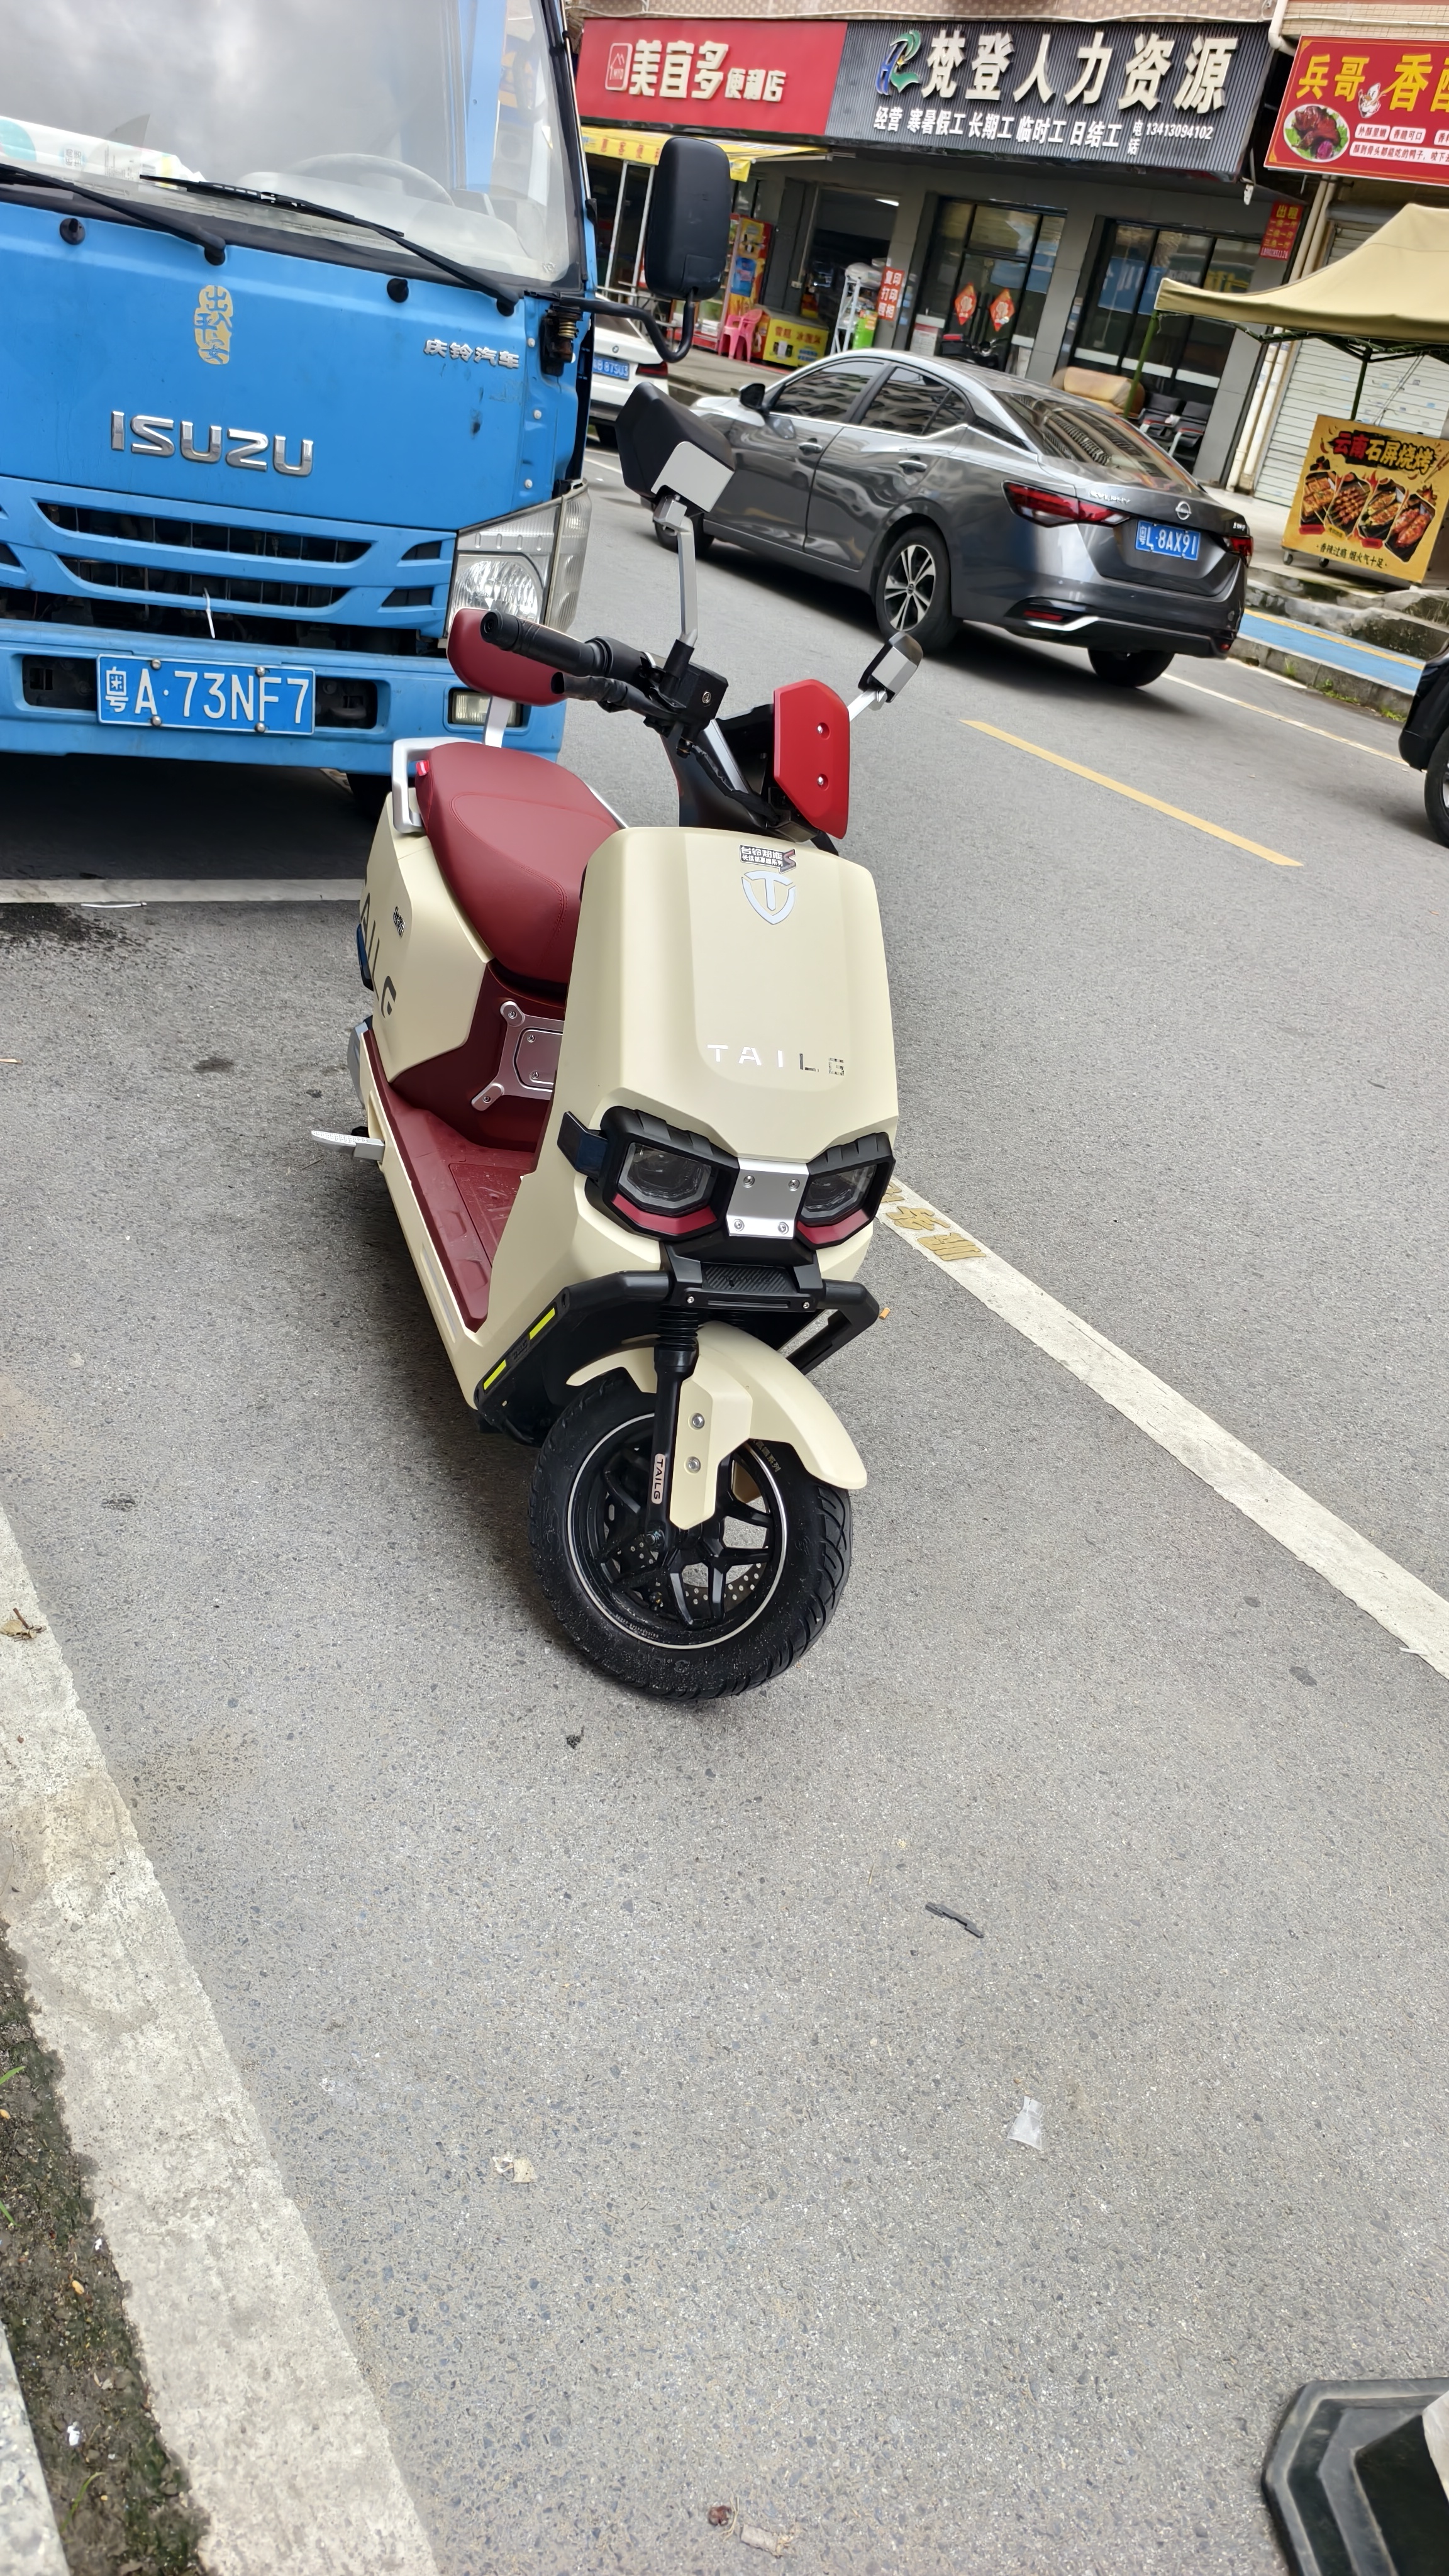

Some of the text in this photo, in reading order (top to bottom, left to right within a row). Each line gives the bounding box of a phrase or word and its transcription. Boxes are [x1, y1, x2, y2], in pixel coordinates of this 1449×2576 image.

[629, 40, 786, 102] 美宜多 便利店
[921, 28, 1238, 114] 梵登人力资源
[1296, 53, 1370, 102] 兵哥
[874, 106, 1122, 148] 经营 寒暑假工 长期工 临时工 日结工
[1146, 122, 1214, 140] 13413094102
[424, 339, 519, 369] 庆铃汽车
[111, 410, 314, 477] ISUZU
[1333, 431, 1435, 474] 云南石屏烧烤
[707, 1044, 845, 1076] TAILG
[653, 1458, 663, 1499] TAILG
